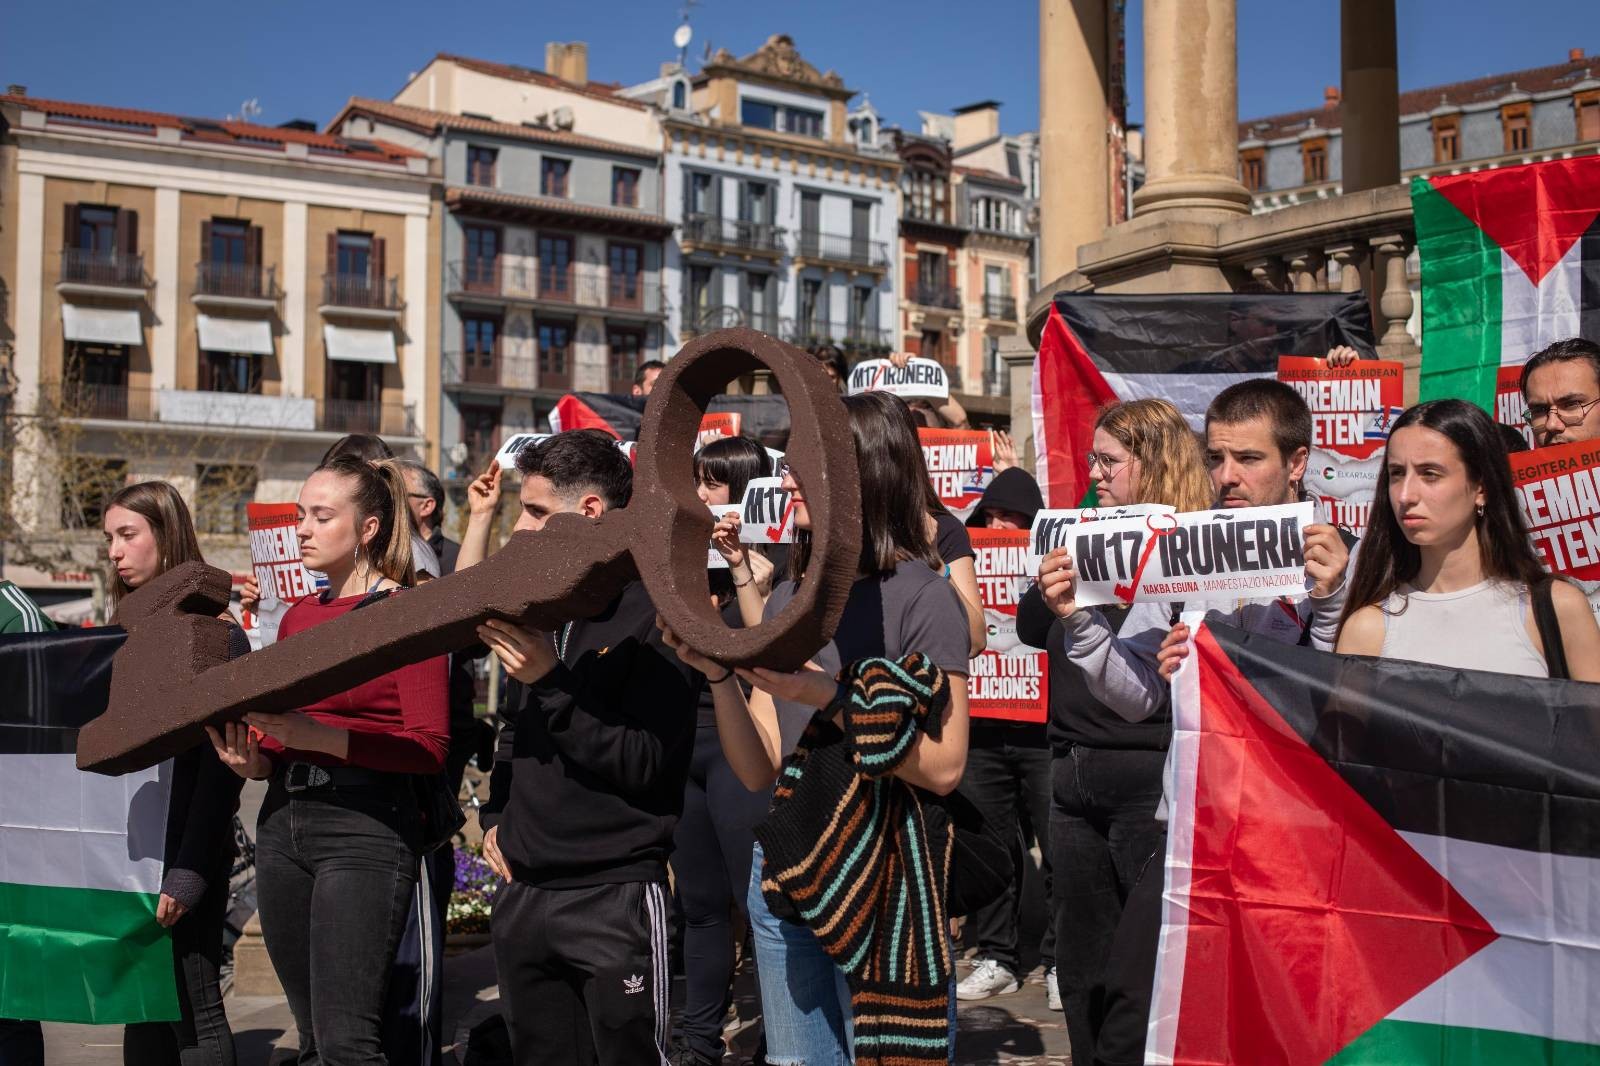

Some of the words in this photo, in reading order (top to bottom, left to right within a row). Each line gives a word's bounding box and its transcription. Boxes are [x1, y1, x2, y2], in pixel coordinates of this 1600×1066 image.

[853, 366, 877, 388] M17
[1301, 368, 1357, 378] DESEGITERA
[1360, 368, 1398, 377] BIDEAN
[1311, 412, 1365, 445] ETEN
[921, 444, 978, 471] REMAN
[927, 471, 963, 498] TEN
[1337, 470, 1379, 479] ELKARTASU
[743, 487, 789, 524] M17
[972, 538, 1014, 546] ESEGITERA
[1076, 530, 1143, 581] M17
[1159, 514, 1305, 578] IRUÑERA
[972, 546, 1029, 575] REMAN
[1142, 582, 1171, 595] NAKBA
[1172, 581, 1199, 593] EGUNA
[1203, 576, 1262, 591] MANIFESTAZIO
[969, 654, 997, 677] URA
[998, 654, 1043, 677] TOTAL
